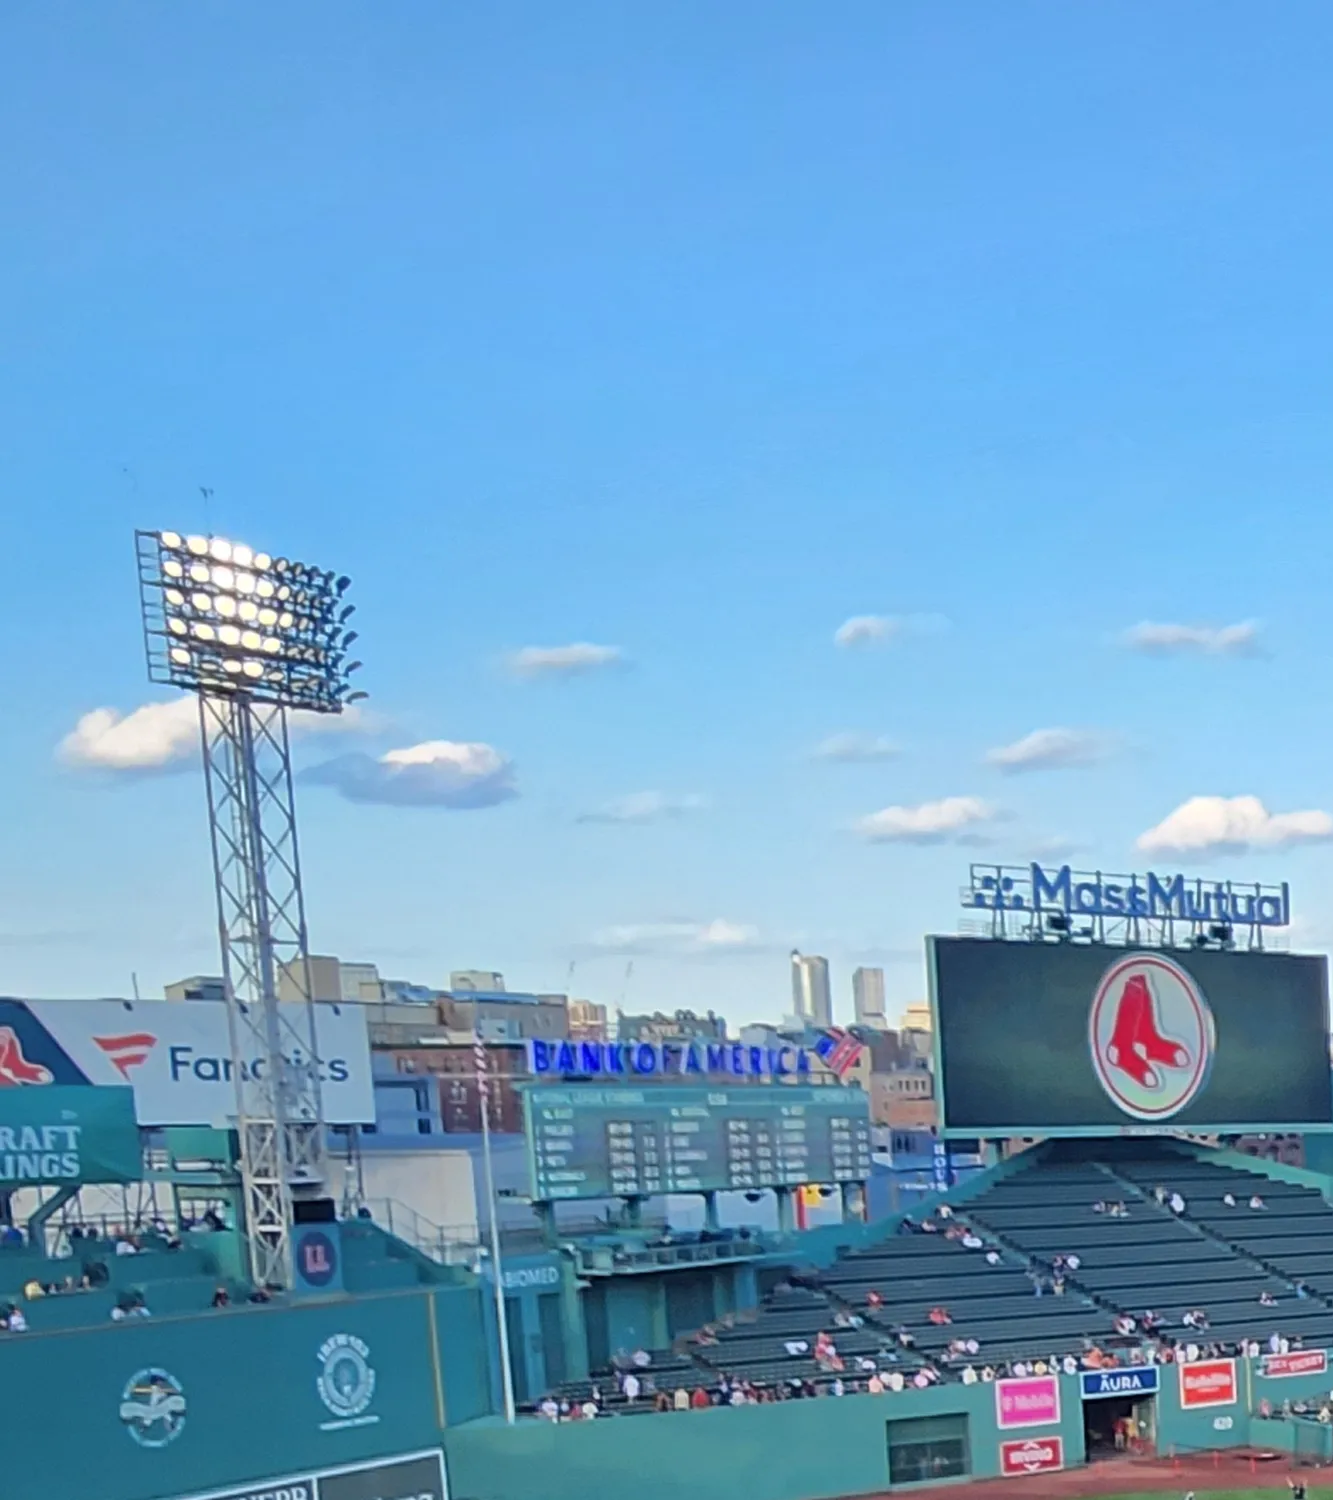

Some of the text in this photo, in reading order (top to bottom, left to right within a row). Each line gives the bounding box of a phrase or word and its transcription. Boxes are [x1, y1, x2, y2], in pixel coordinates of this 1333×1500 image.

[1030, 862, 1290, 925] MassMutual
[169, 1046, 349, 1082] Fanaics
[531, 1039, 811, 1075] BANK OF AMERICA
[0, 1153, 81, 1179] INGS
